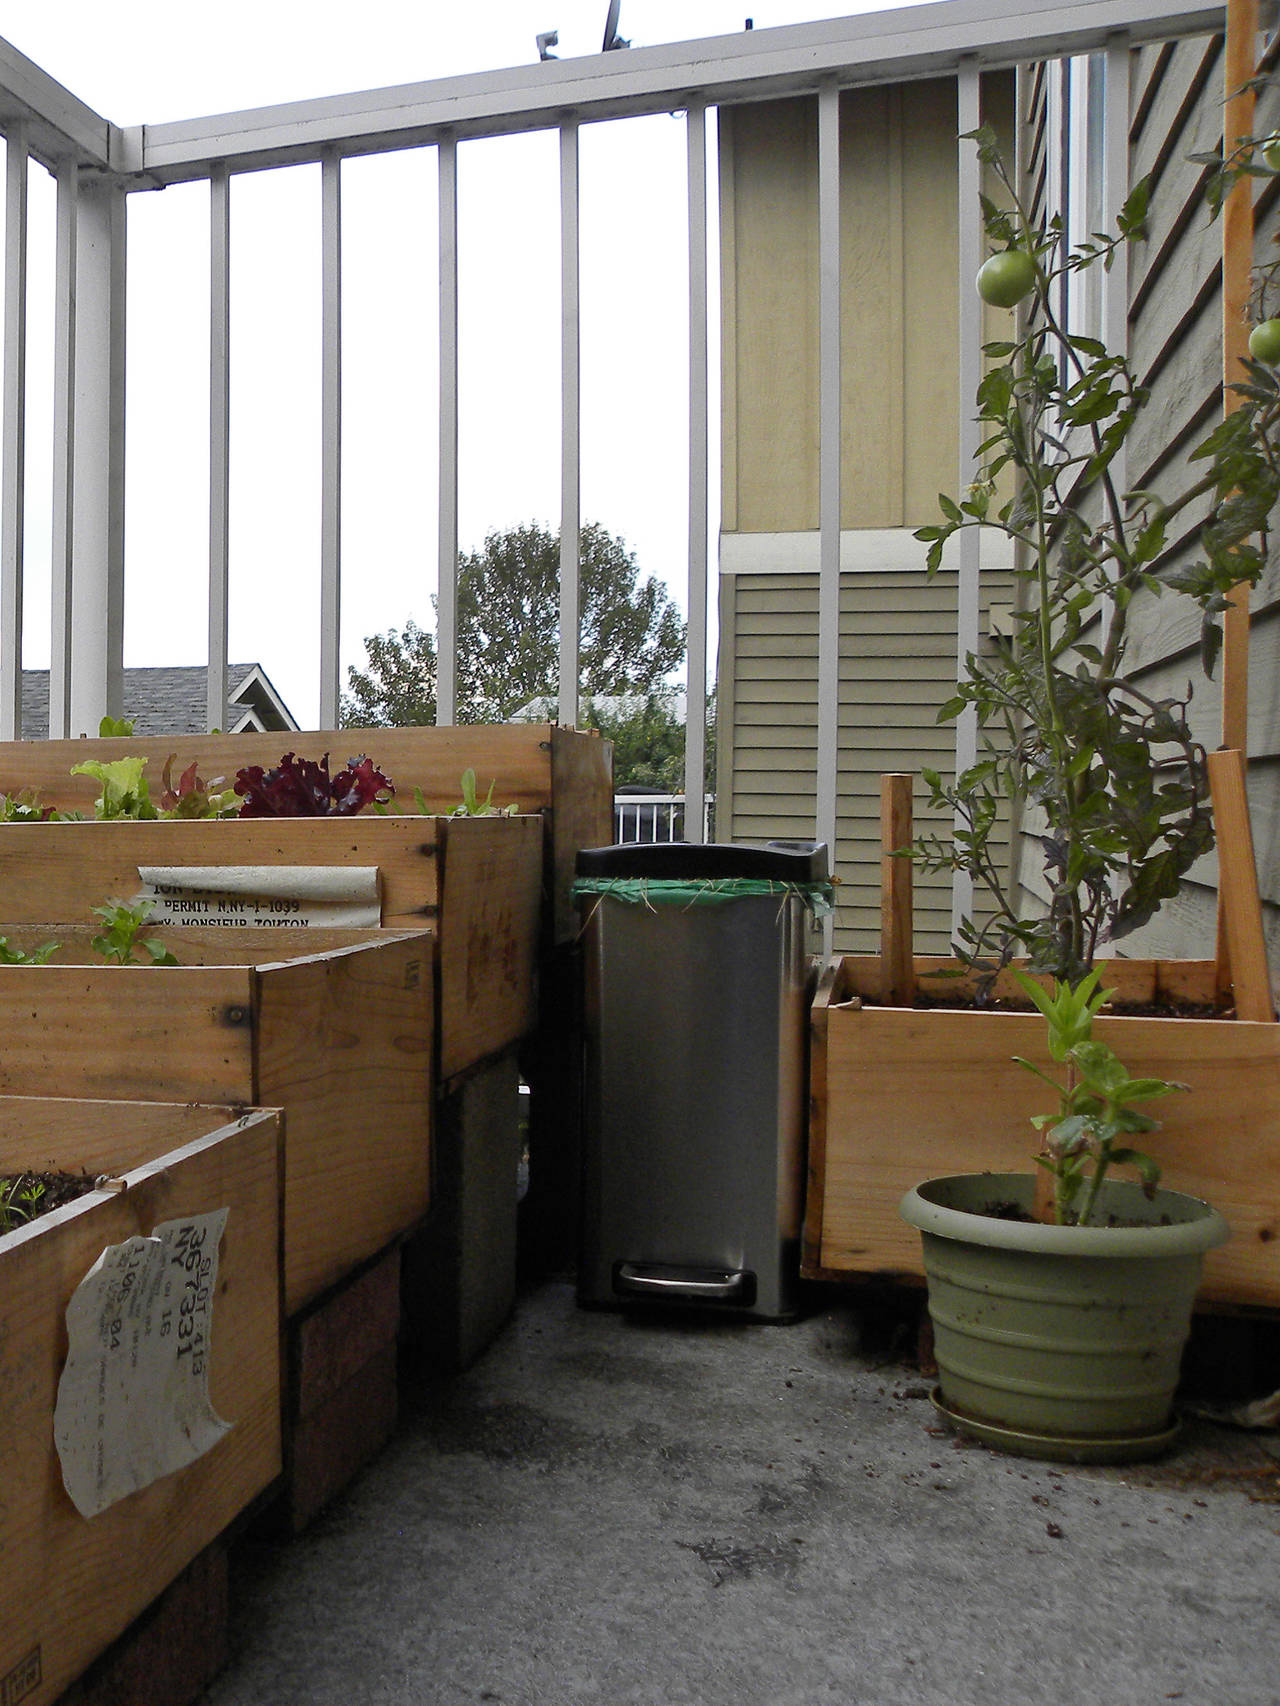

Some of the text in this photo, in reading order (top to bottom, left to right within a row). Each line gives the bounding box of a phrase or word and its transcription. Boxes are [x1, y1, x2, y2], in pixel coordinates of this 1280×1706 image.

[164, 899, 211, 912] PERMIT
[171, 1225, 196, 1269] NY
[194, 1256, 212, 1315] SLOT
